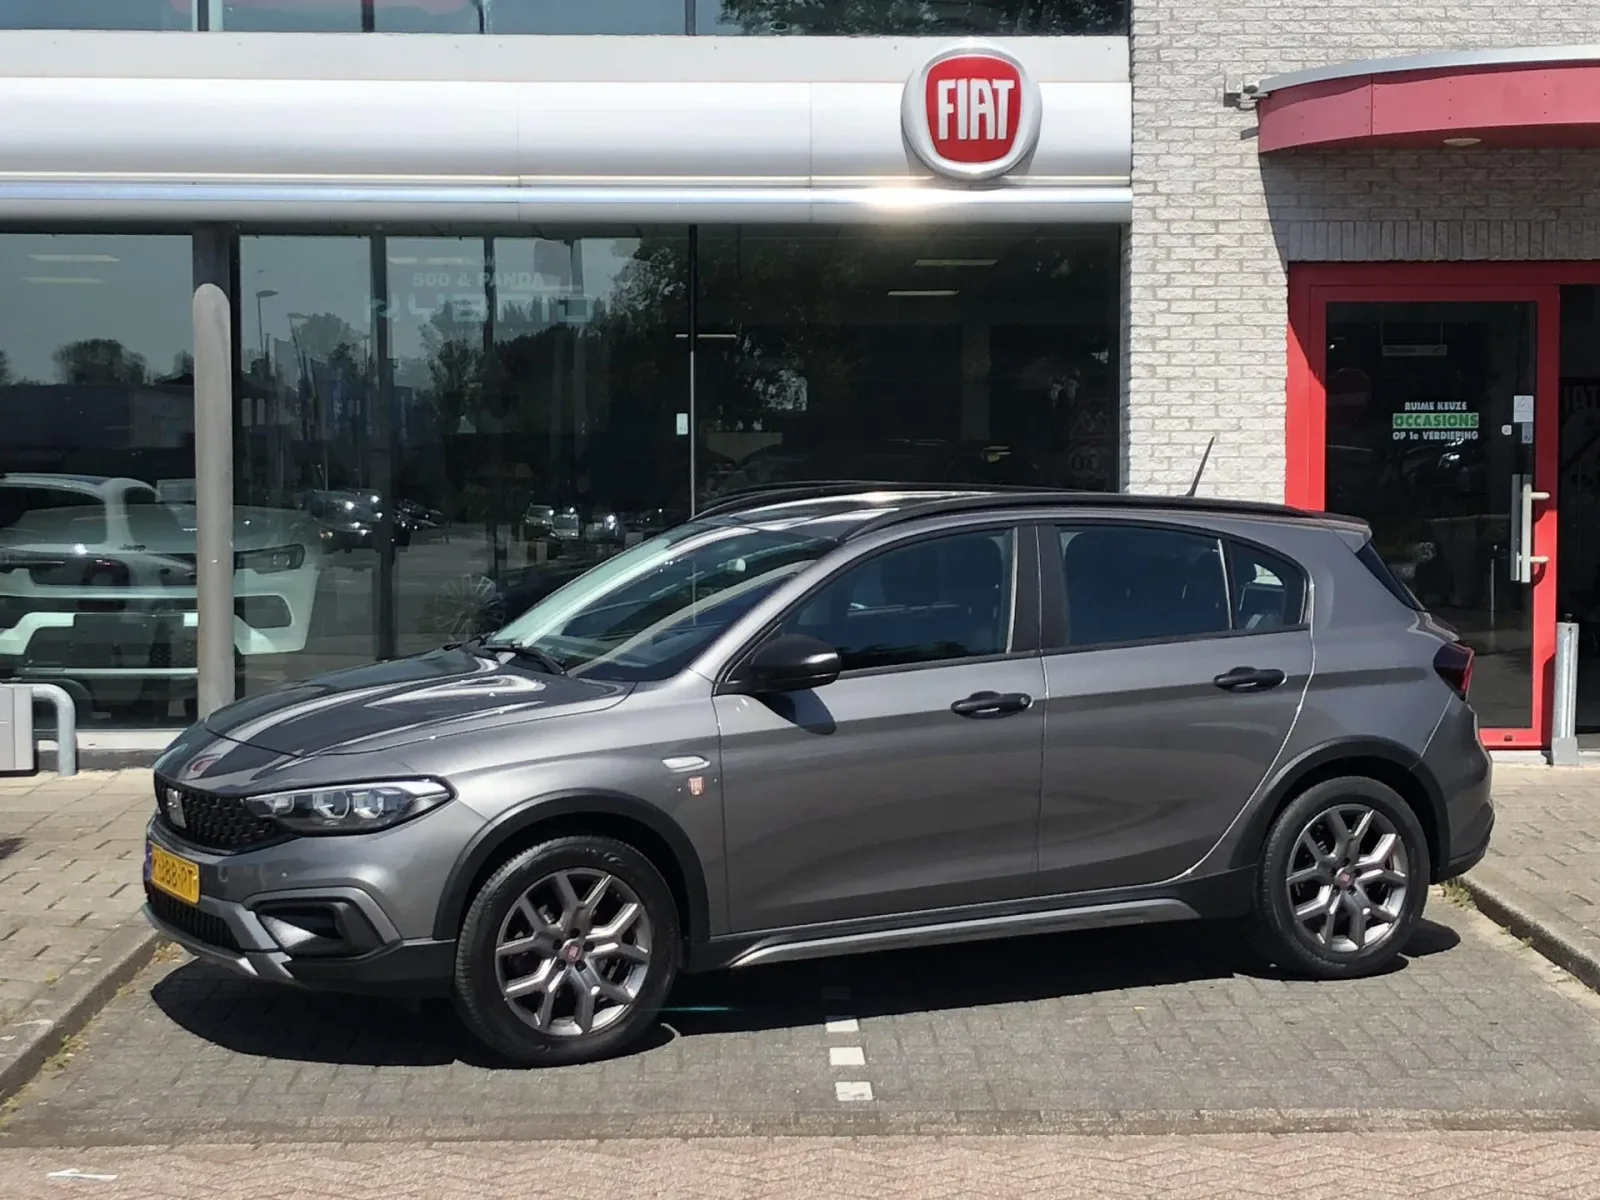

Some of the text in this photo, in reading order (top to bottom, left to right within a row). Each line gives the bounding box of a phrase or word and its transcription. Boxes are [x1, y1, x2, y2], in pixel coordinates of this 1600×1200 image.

[937, 78, 1015, 140] FIAT
[412, 272, 545, 288] 500 & PANDA
[1404, 401, 1468, 411] RUIME KEUZE
[1394, 414, 1478, 427] OCCASIONS
[1392, 431, 1407, 440] OP
[1422, 430, 1479, 440] VERDIEPING
